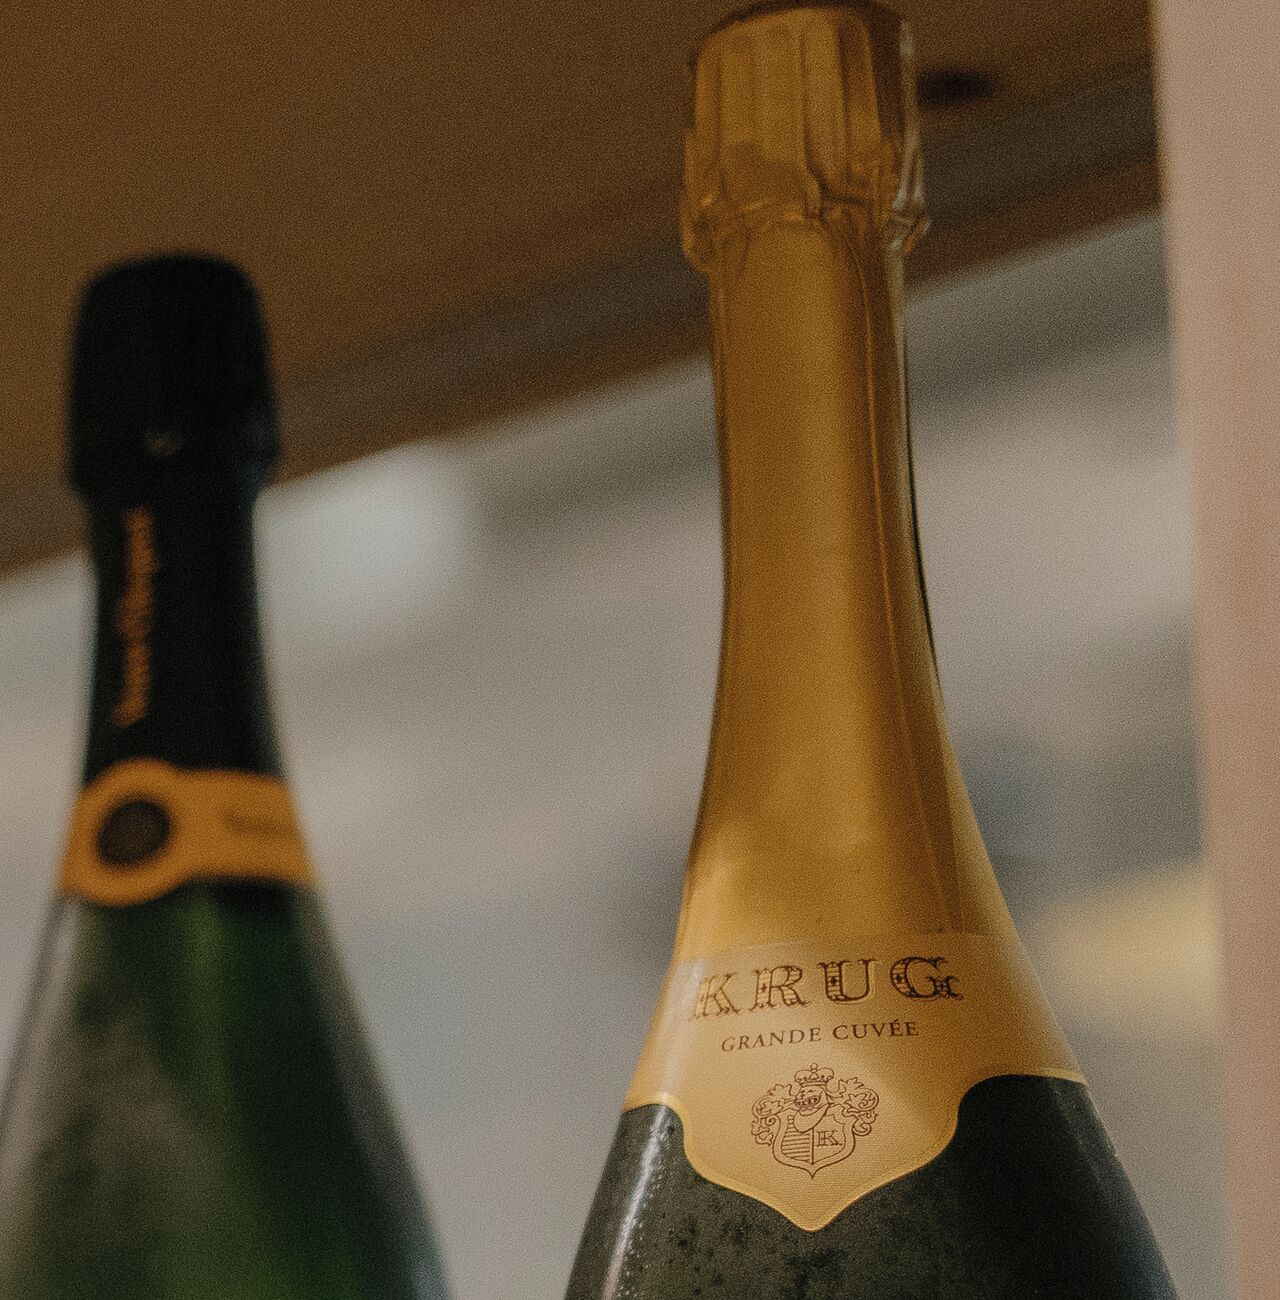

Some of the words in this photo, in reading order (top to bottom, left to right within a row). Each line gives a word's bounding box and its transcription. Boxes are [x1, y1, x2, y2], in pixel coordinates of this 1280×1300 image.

[689, 956, 964, 1022] KRUG
[721, 1027, 822, 1053] GRANDE
[832, 1018, 919, 1042] CUVÉE
